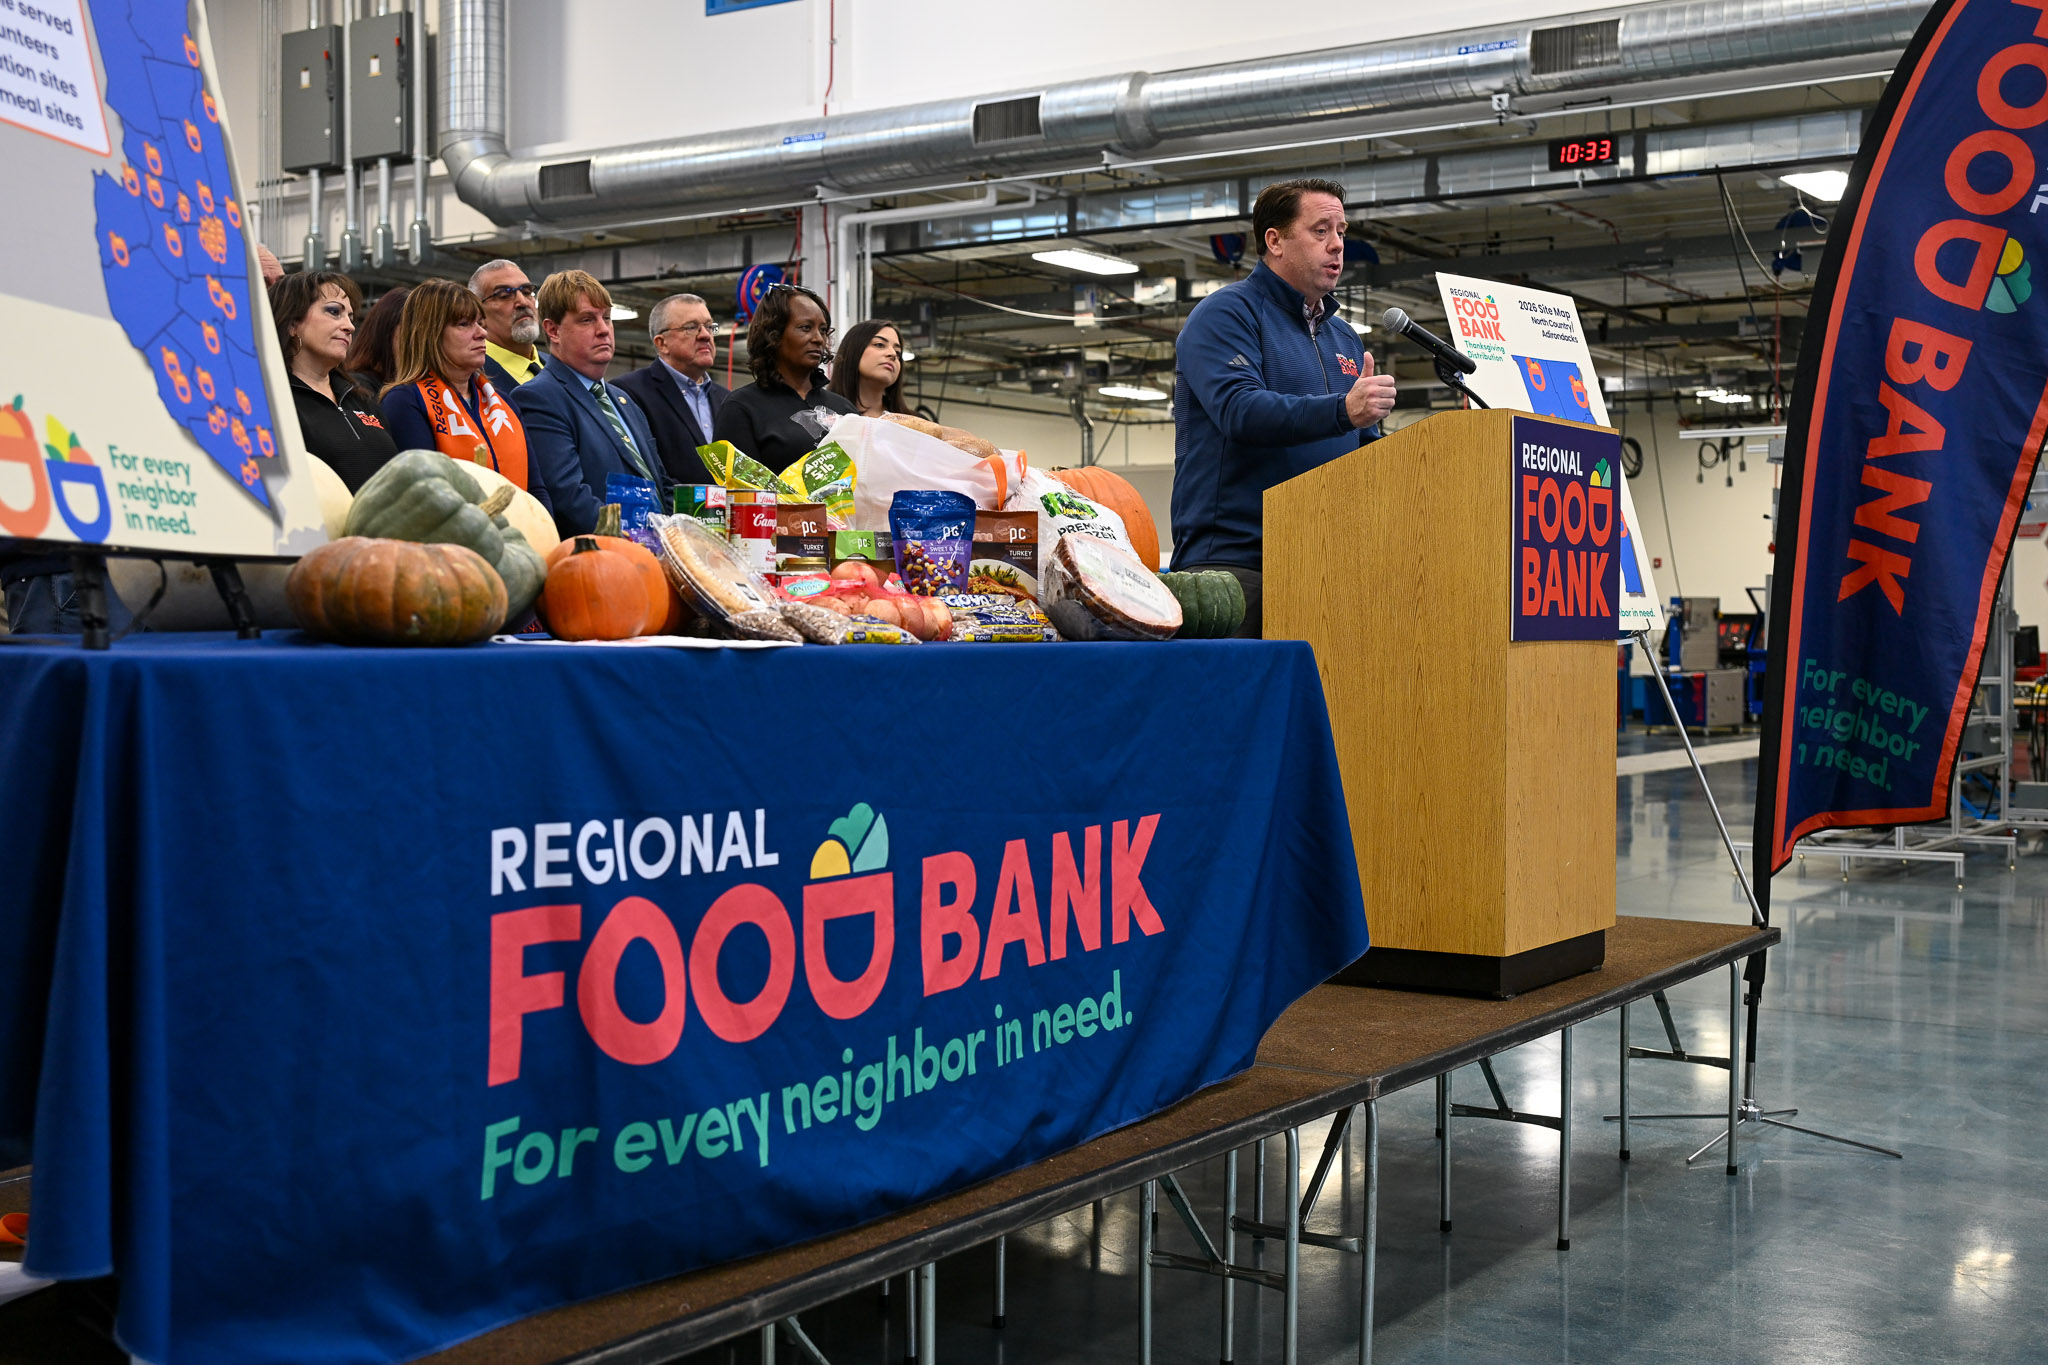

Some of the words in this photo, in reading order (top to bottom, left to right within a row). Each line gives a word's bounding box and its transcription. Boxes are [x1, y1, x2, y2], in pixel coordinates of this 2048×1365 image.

[18, 1, 73, 35] served
[40, 69, 78, 97] sites
[45, 102, 83, 130] sites
[1560, 139, 1611, 163] 10:33
[1914, 0, 2048, 312] OOD
[1449, 287, 1482, 300] REGIONAL
[1452, 296, 1499, 321] FOOD
[1518, 299, 1538, 313] 2026
[1537, 303, 1553, 316] Site
[1553, 306, 1571, 321] Map
[1530, 315, 1549, 327] North
[1457, 316, 1506, 342] BANK
[1541, 329, 1579, 344] Adirondacks
[1464, 339, 1506, 354] Thanksgiving
[1467, 350, 1504, 362] Distribution
[422, 374, 449, 435] REGION
[107, 444, 138, 470] For
[143, 458, 191, 486] every
[804, 451, 838, 475] Apples
[1522, 442, 1583, 477] REGIONAL
[1836, 316, 1974, 618] BANK
[117, 476, 198, 510] neighbor
[122, 504, 143, 531] in
[146, 510, 197, 536] need.
[1522, 474, 1613, 547] FOOD
[803, 543, 824, 551] TURKEY
[1521, 546, 1611, 618] BANK
[1638, 607, 1657, 618] need.
[1802, 658, 1847, 692] For
[1851, 677, 1929, 734] every
[1813, 744, 1892, 792] need.
[490, 808, 779, 895] REGIONAL
[487, 871, 895, 1087] FOOD
[921, 813, 1165, 997] BANK
[480, 1116, 599, 1201] For
[612, 1092, 770, 1168] every
[781, 1028, 986, 1132] neighbor
[995, 1004, 1024, 1067] in
[1031, 969, 1134, 1053] need.
